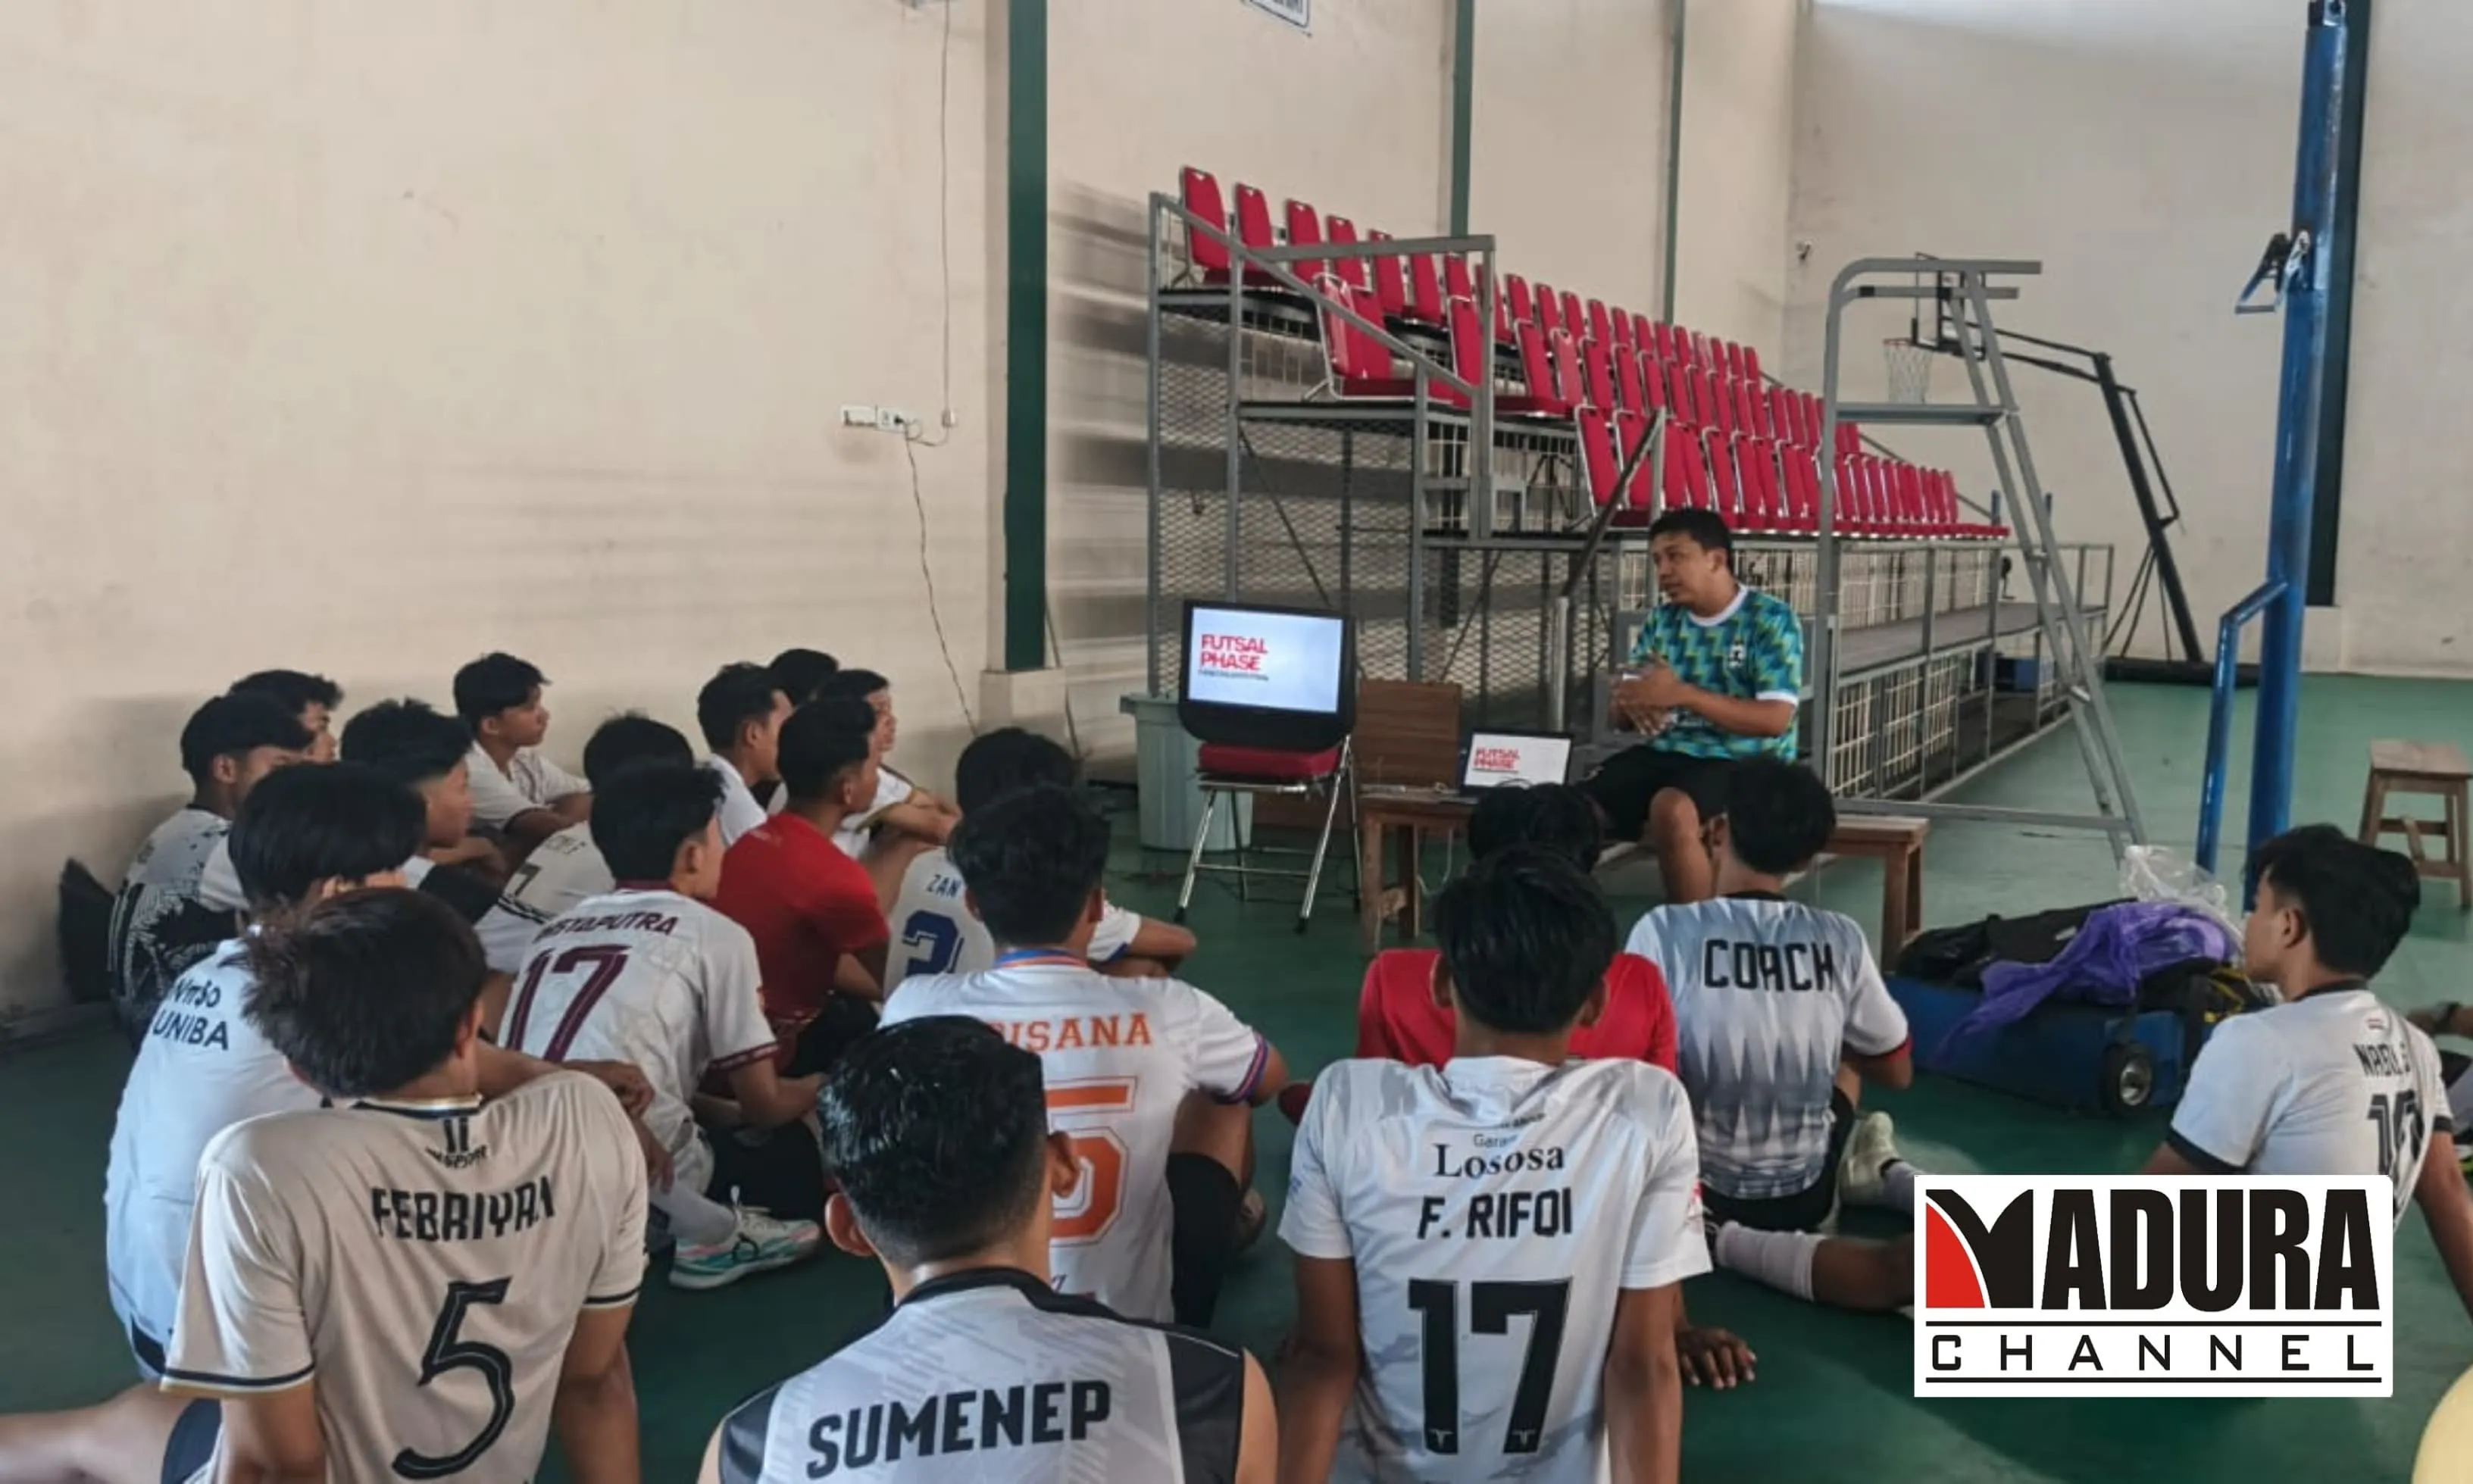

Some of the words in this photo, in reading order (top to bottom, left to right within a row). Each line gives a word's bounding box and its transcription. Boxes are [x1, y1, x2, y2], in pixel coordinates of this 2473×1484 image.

[1200, 651, 1261, 670] PHASE
[1201, 634, 1268, 655] FUTSAL
[1704, 939, 1834, 992] COACH
[153, 1009, 230, 1051] UNIBA
[505, 944, 633, 1064] 17
[1433, 1142, 1565, 1179] Lososa
[1418, 1195, 1451, 1239] F.
[1465, 1187, 1572, 1239] RIFOI
[392, 1275, 515, 1480] 5
[1408, 1276, 1574, 1454] 17
[806, 1379, 1111, 1479] SUMENEP
